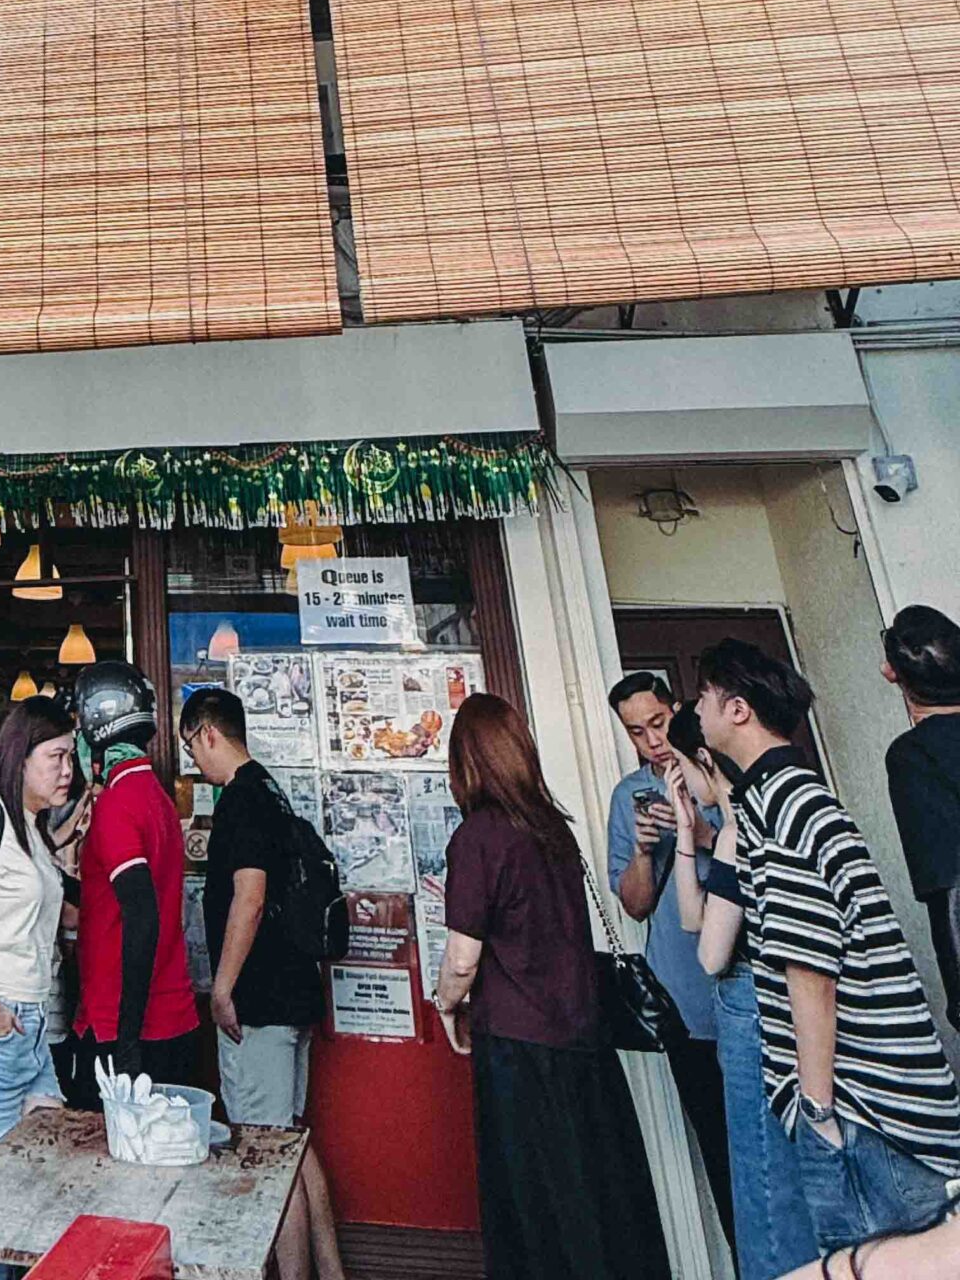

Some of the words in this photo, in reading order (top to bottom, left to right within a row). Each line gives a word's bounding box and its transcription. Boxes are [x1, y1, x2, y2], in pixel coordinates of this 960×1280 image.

[321, 569, 369, 586] Queue
[372, 569, 384, 584] is
[304, 591, 321, 606] 15
[326, 613, 356, 628] wait
[359, 613, 388, 628] time
